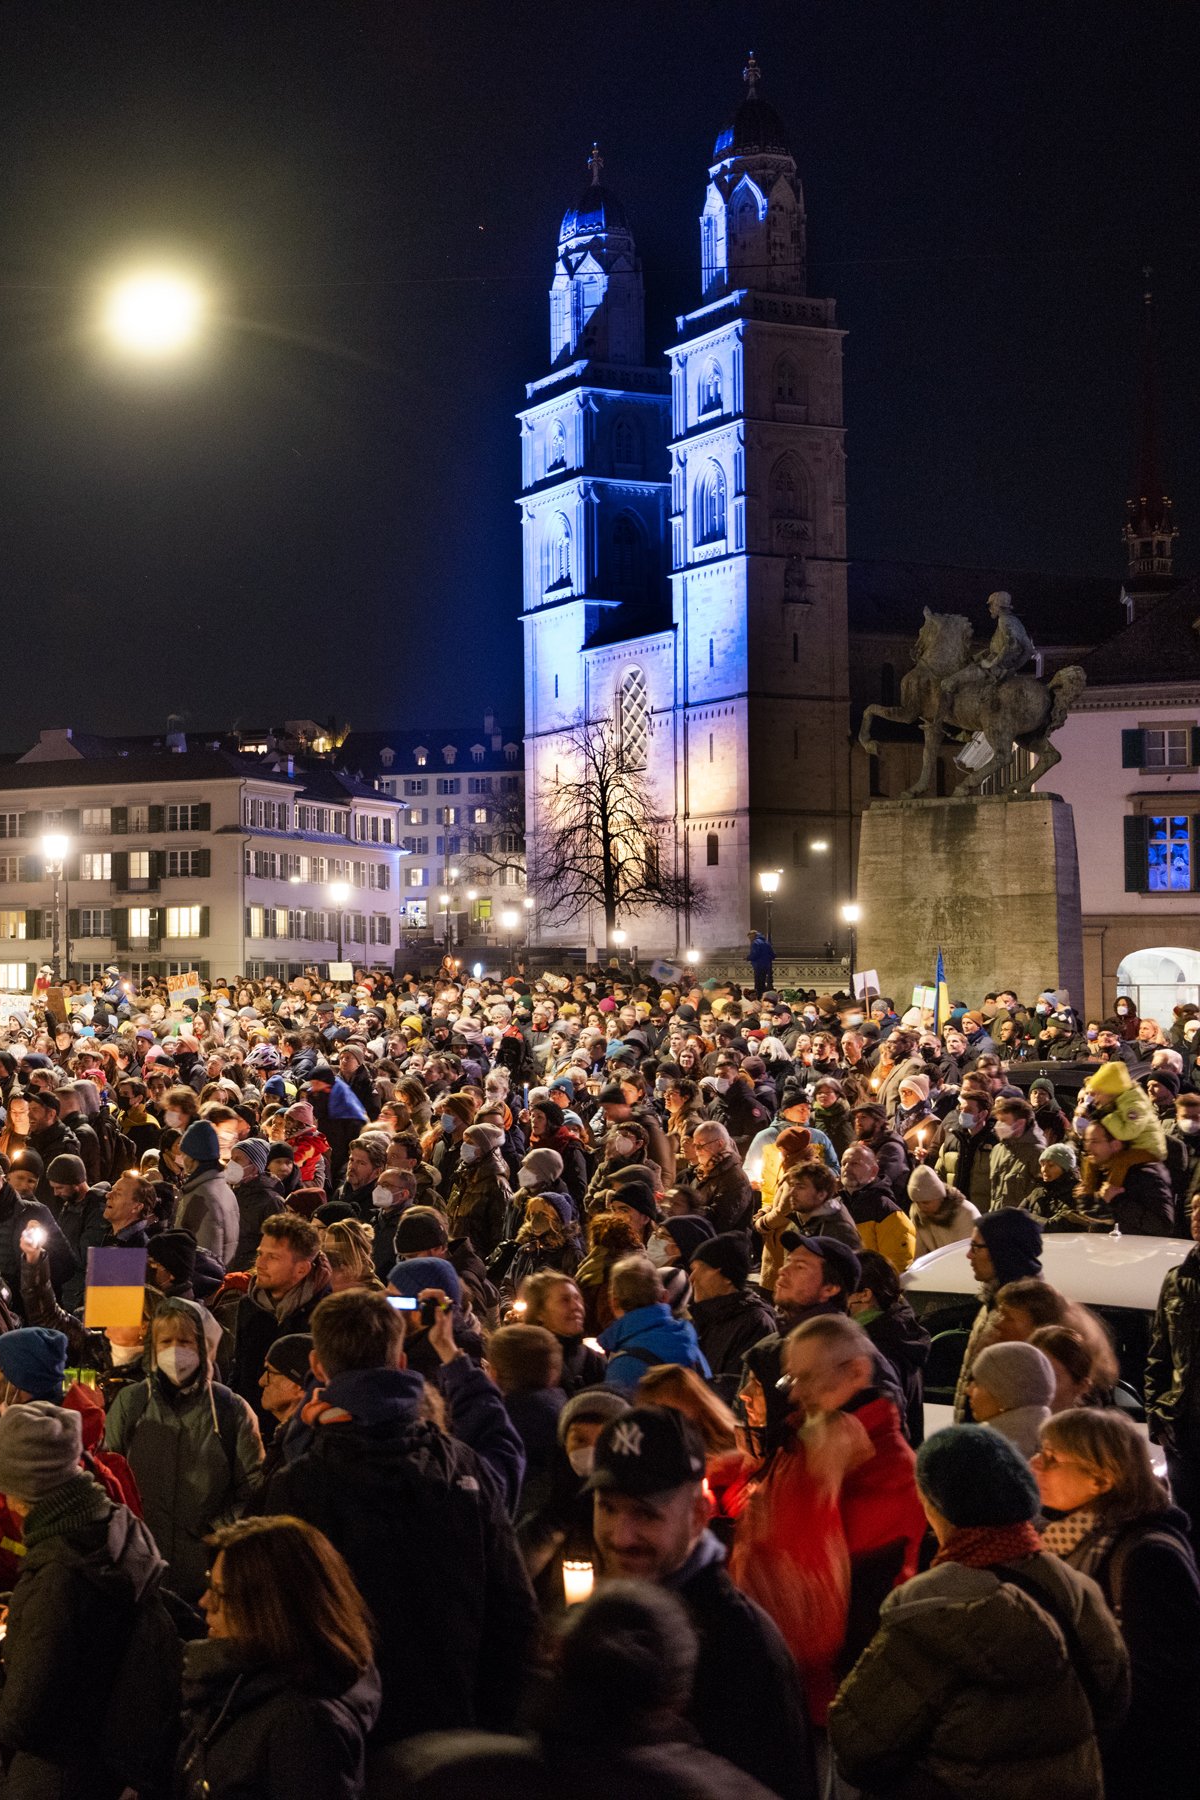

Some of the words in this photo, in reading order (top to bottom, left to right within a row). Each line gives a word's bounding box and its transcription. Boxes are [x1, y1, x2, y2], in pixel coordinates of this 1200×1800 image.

[918, 927, 992, 941] WALDMANN
[168, 976, 184, 992] STOP
[611, 1422, 645, 1457] NY
